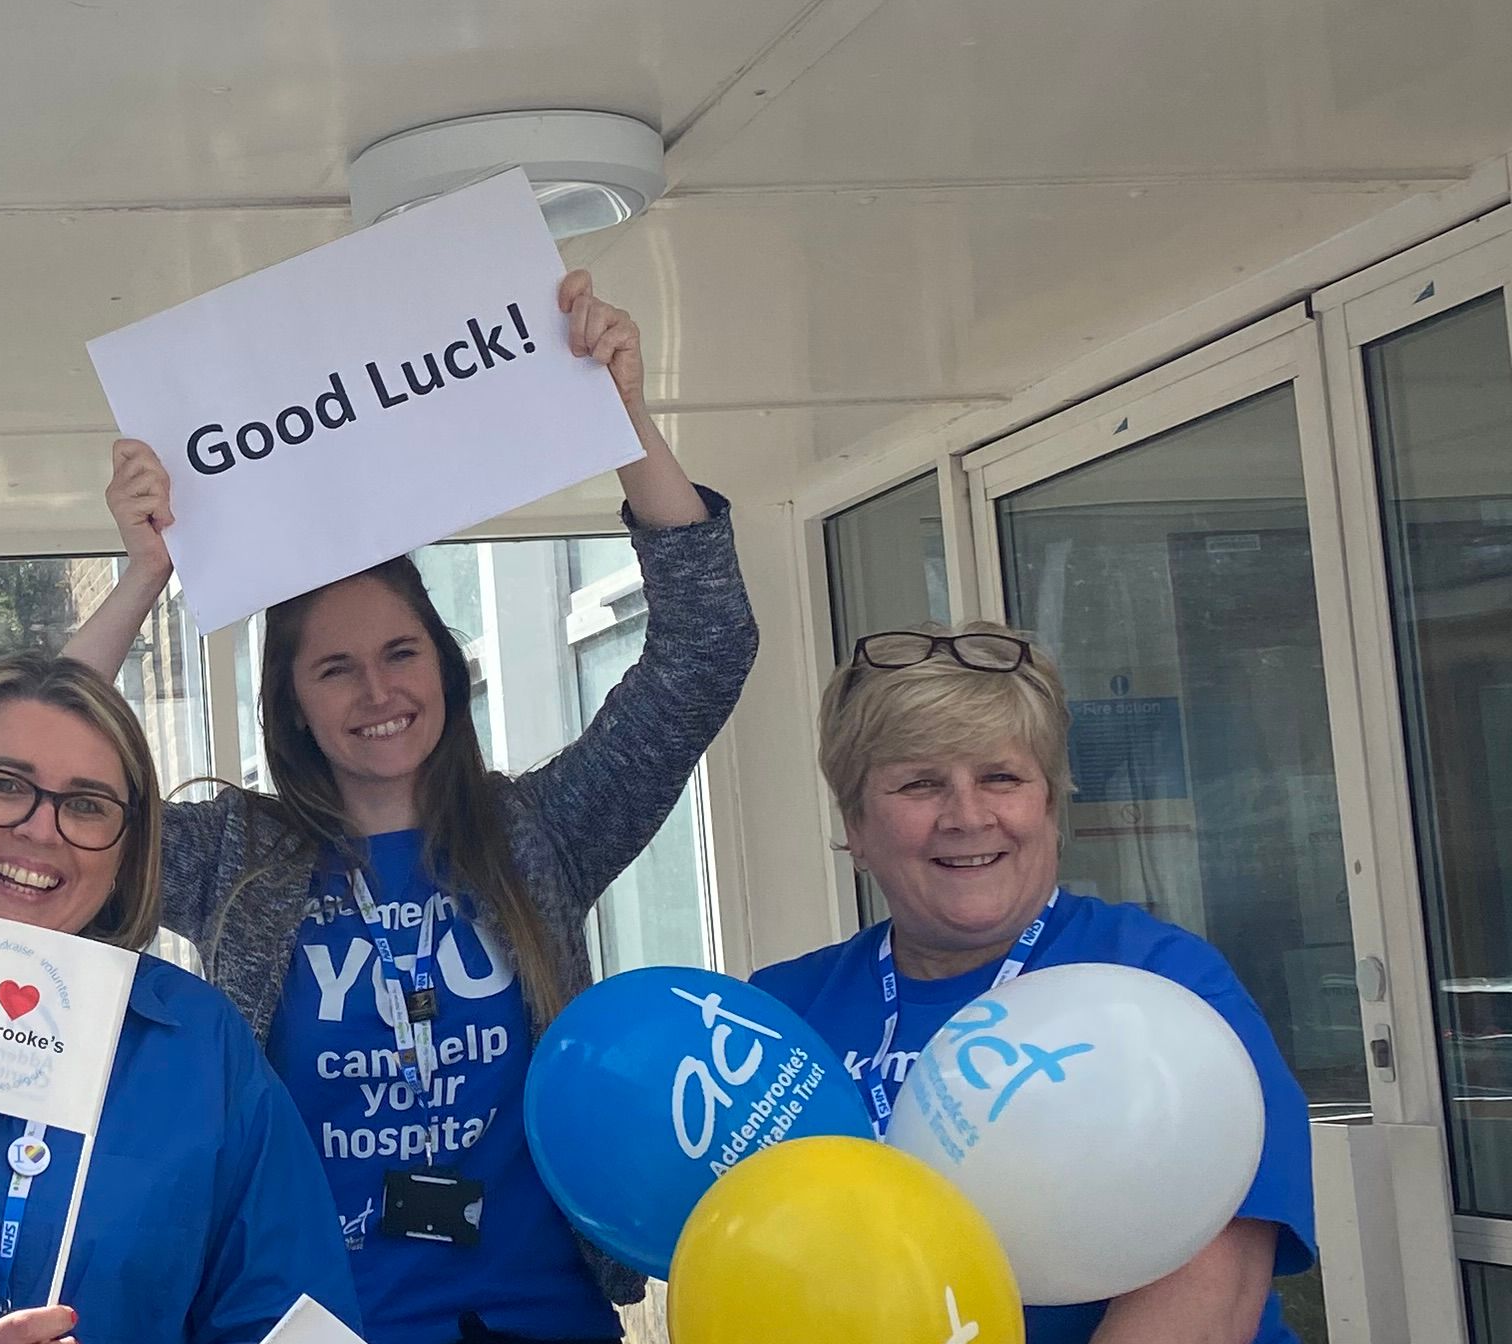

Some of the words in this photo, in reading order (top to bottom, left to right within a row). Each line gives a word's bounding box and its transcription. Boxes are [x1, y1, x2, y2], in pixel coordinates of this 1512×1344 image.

[186, 372, 357, 476] Good
[365, 302, 536, 409] Luck!
[1083, 703, 1111, 715] Fire
[1116, 702, 1161, 714] action
[1022, 920, 1042, 945] NHS
[40, 959, 71, 1010] volunteer
[885, 974, 895, 1000] NHS
[317, 1048, 399, 1079] can
[671, 987, 783, 1159] act
[792, 1062, 826, 1101] Trust
[709, 1047, 808, 1179] Addenbrooke's
[873, 1087, 888, 1116] NHS
[2, 1223, 16, 1255] NHS
